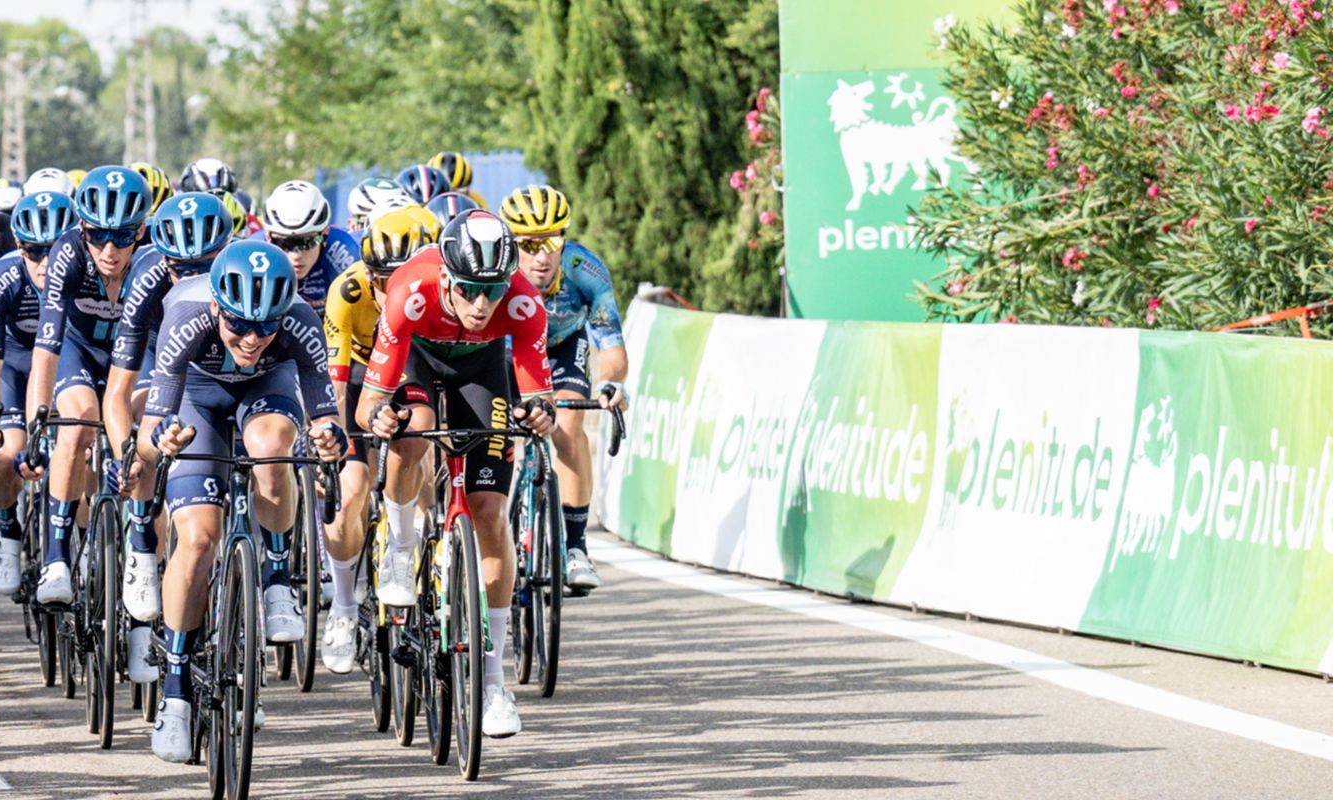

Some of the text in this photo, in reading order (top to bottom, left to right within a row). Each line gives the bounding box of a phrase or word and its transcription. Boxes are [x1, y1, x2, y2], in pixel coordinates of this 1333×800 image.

[44, 242, 76, 312] youfone
[156, 312, 213, 377] youfone
[487, 396, 509, 460] JUBO
